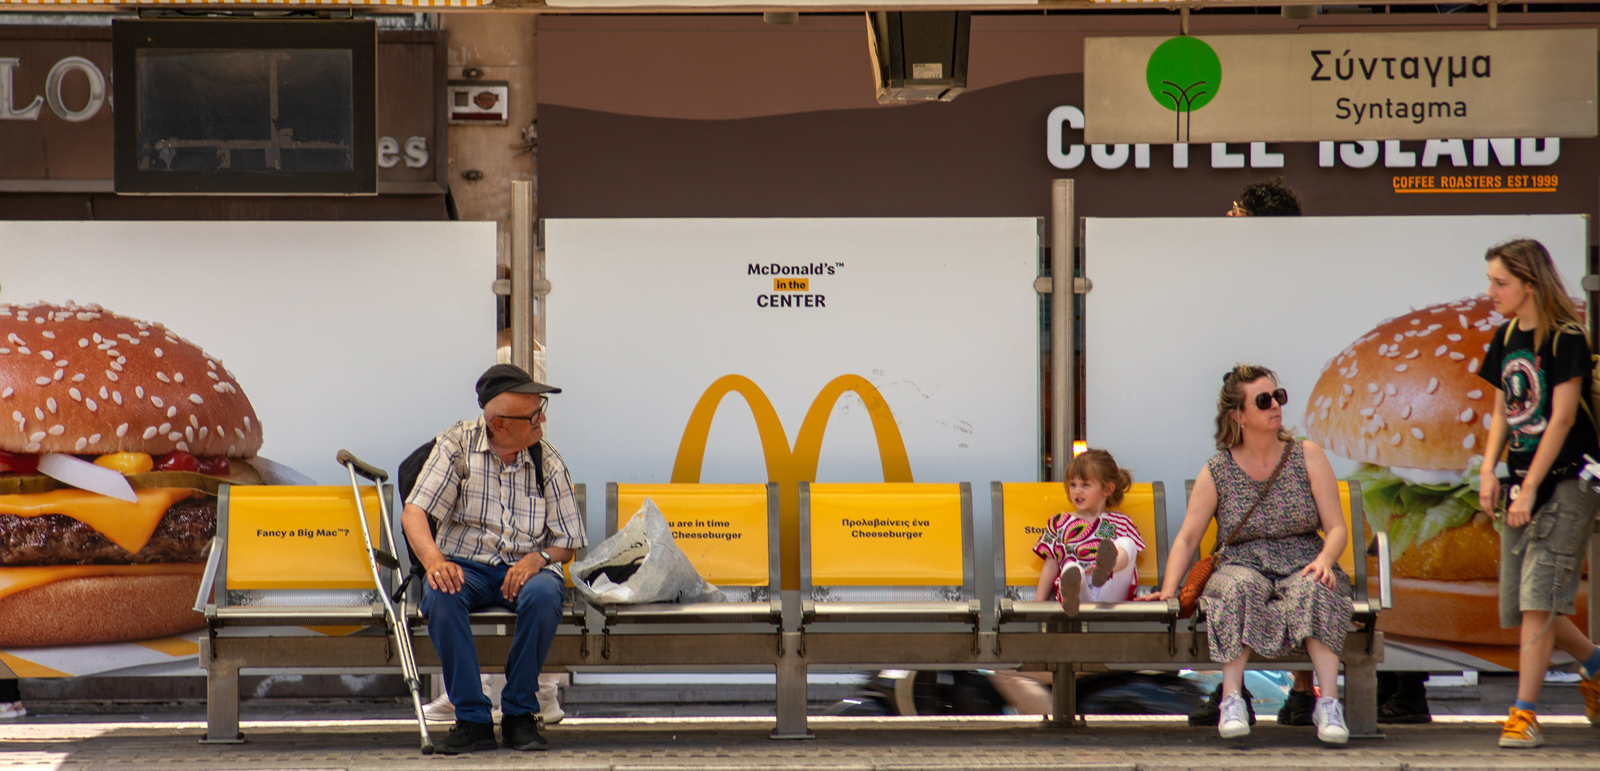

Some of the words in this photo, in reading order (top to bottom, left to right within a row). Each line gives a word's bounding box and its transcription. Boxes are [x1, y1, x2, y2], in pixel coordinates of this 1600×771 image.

[1310, 49, 1491, 88] Σύνταγμα
[1335, 98, 1467, 125] Syntagma
[1392, 176, 1435, 189] COFFEE
[1440, 176, 1502, 188] ROASTERS
[1507, 175, 1529, 188] EST
[1531, 175, 1559, 187] 1999
[776, 280, 786, 289] in
[788, 280, 806, 289] the
[757, 294, 826, 308] CENTER
[695, 519, 705, 527] in
[707, 519, 730, 527] time
[842, 518, 910, 528] Προλαβαίνεις
[912, 518, 930, 527] ένα
[256, 529, 287, 539] Fancy
[297, 528, 314, 539] Big
[671, 531, 742, 541] Cheeseburger
[851, 530, 923, 540] Cheeseburger
